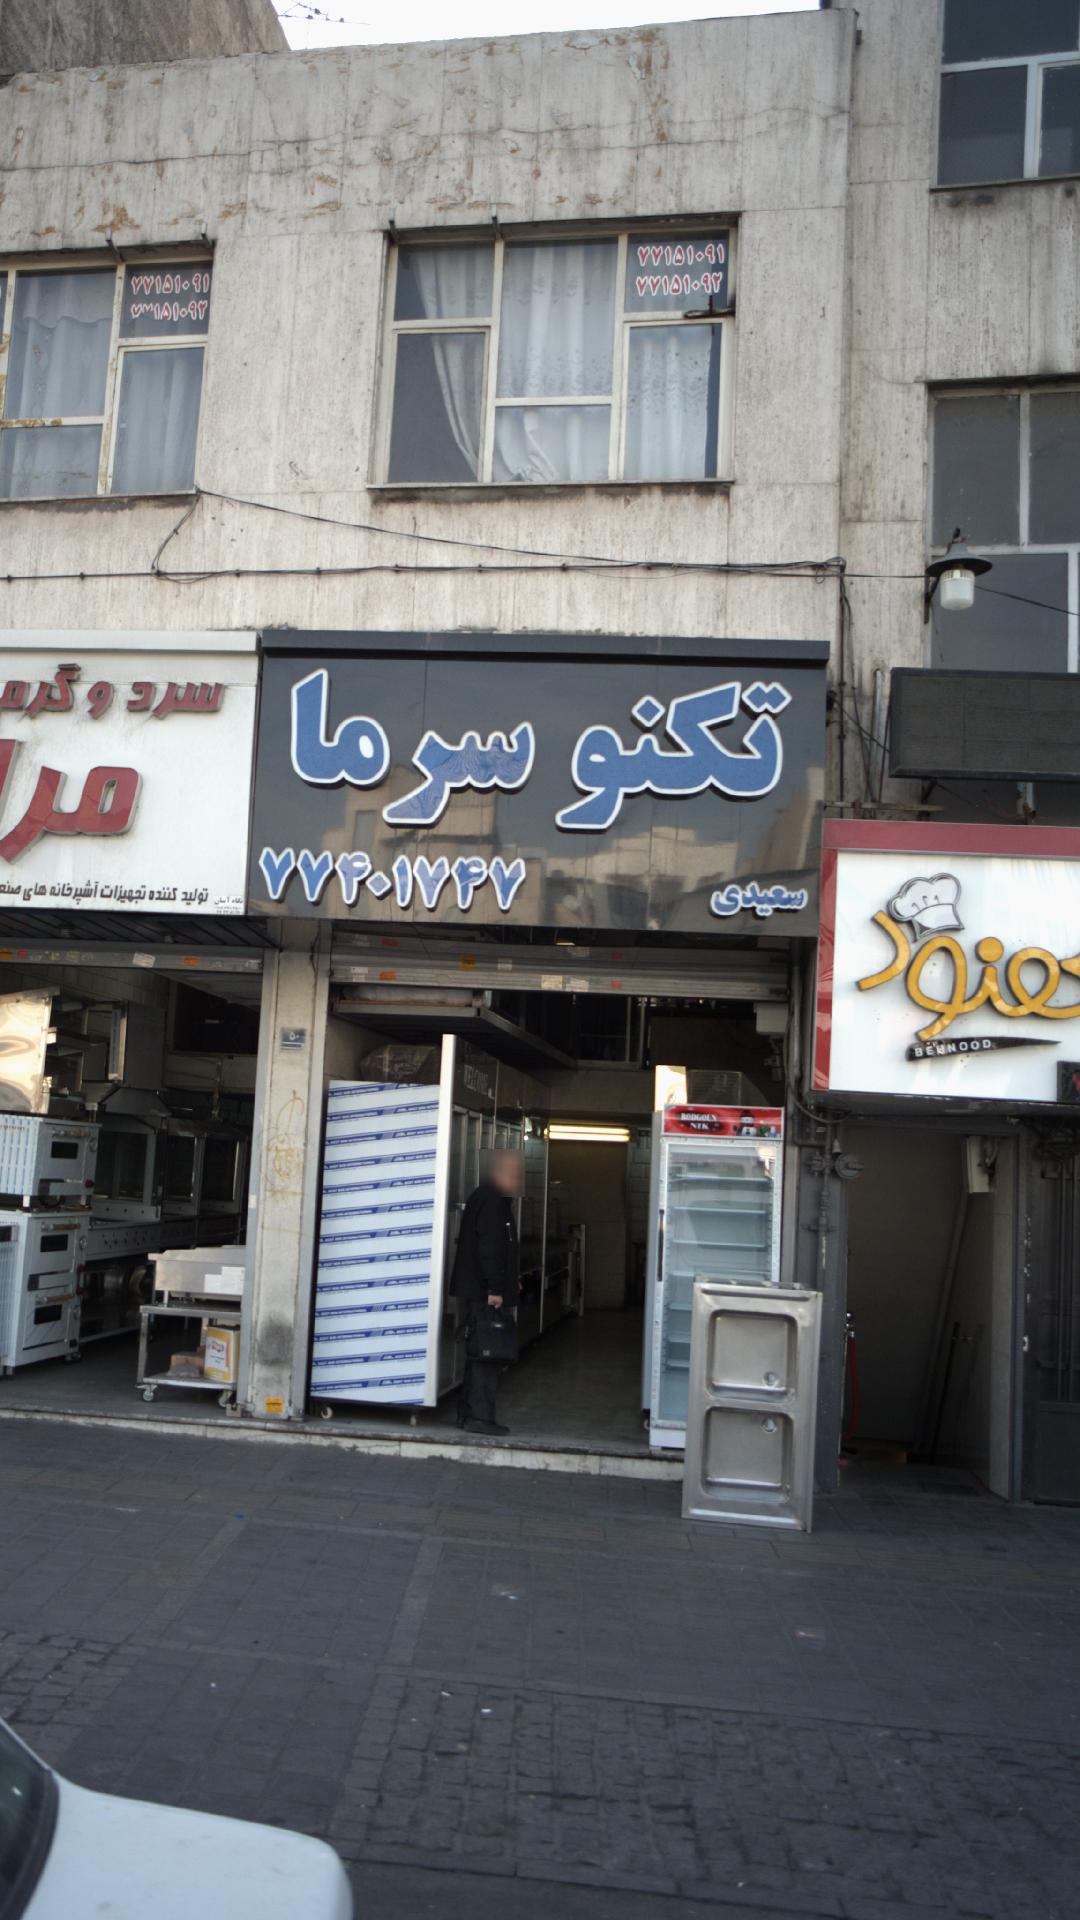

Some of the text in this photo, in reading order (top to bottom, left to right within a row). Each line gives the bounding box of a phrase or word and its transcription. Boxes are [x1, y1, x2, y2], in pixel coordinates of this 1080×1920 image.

[636, 243, 725, 267] ۷۷۱۵۱۰۹۱
[130, 272, 210, 296] ۷۷۱۵۱۰۹۱
[87, 680, 114, 720] و
[127, 681, 227, 720] سرد
[555, 681, 792, 830] تکنو
[259, 847, 526, 911] ۷۷۴۰۱۷۴۷
[100, 884, 146, 904] تجهیزات
[148, 886, 178, 901] کننده
[181, 887, 209, 906] تولید
[711, 881, 808, 916] سعیدی
[914, 1039, 992, 1057] BEHNOOD
